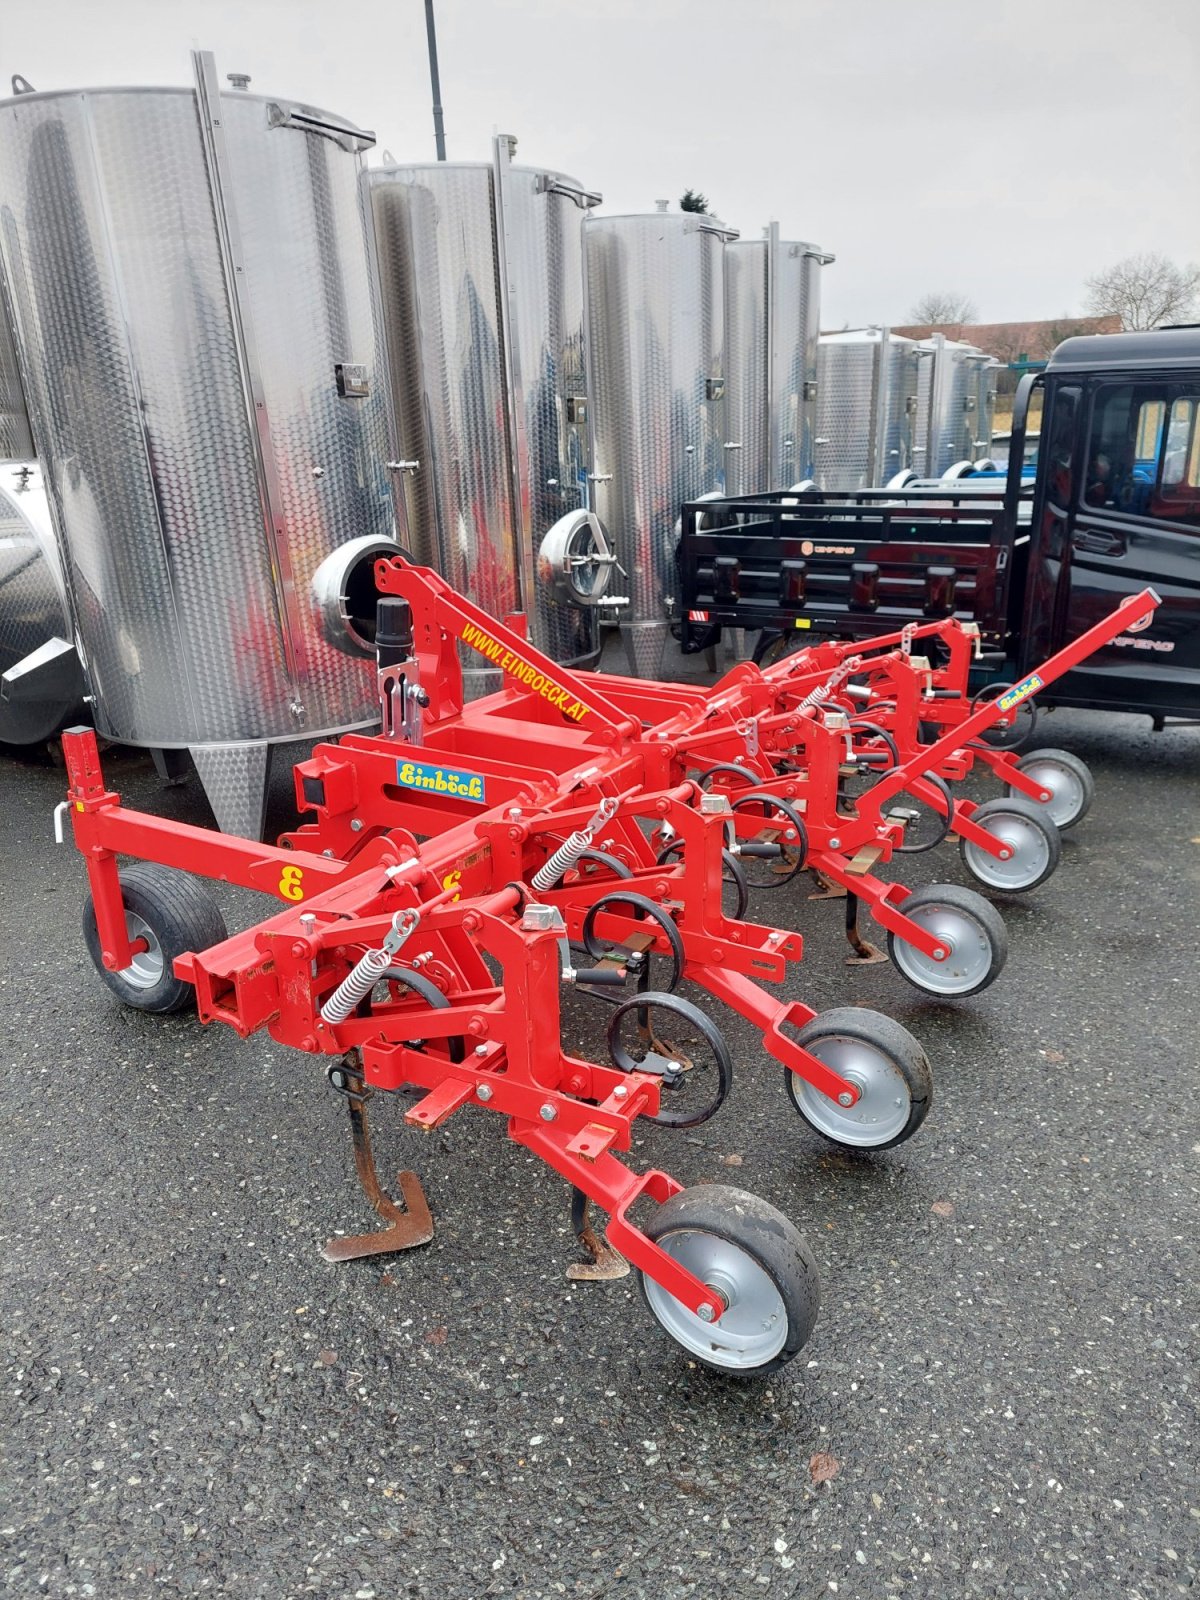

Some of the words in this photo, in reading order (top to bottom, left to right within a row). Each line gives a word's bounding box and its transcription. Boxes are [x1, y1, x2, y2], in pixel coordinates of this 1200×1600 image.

[461, 622, 590, 721] WWW.EINBOECK.AT
[1000, 676, 1041, 710] Einböck
[399, 763, 482, 799] Einböck
